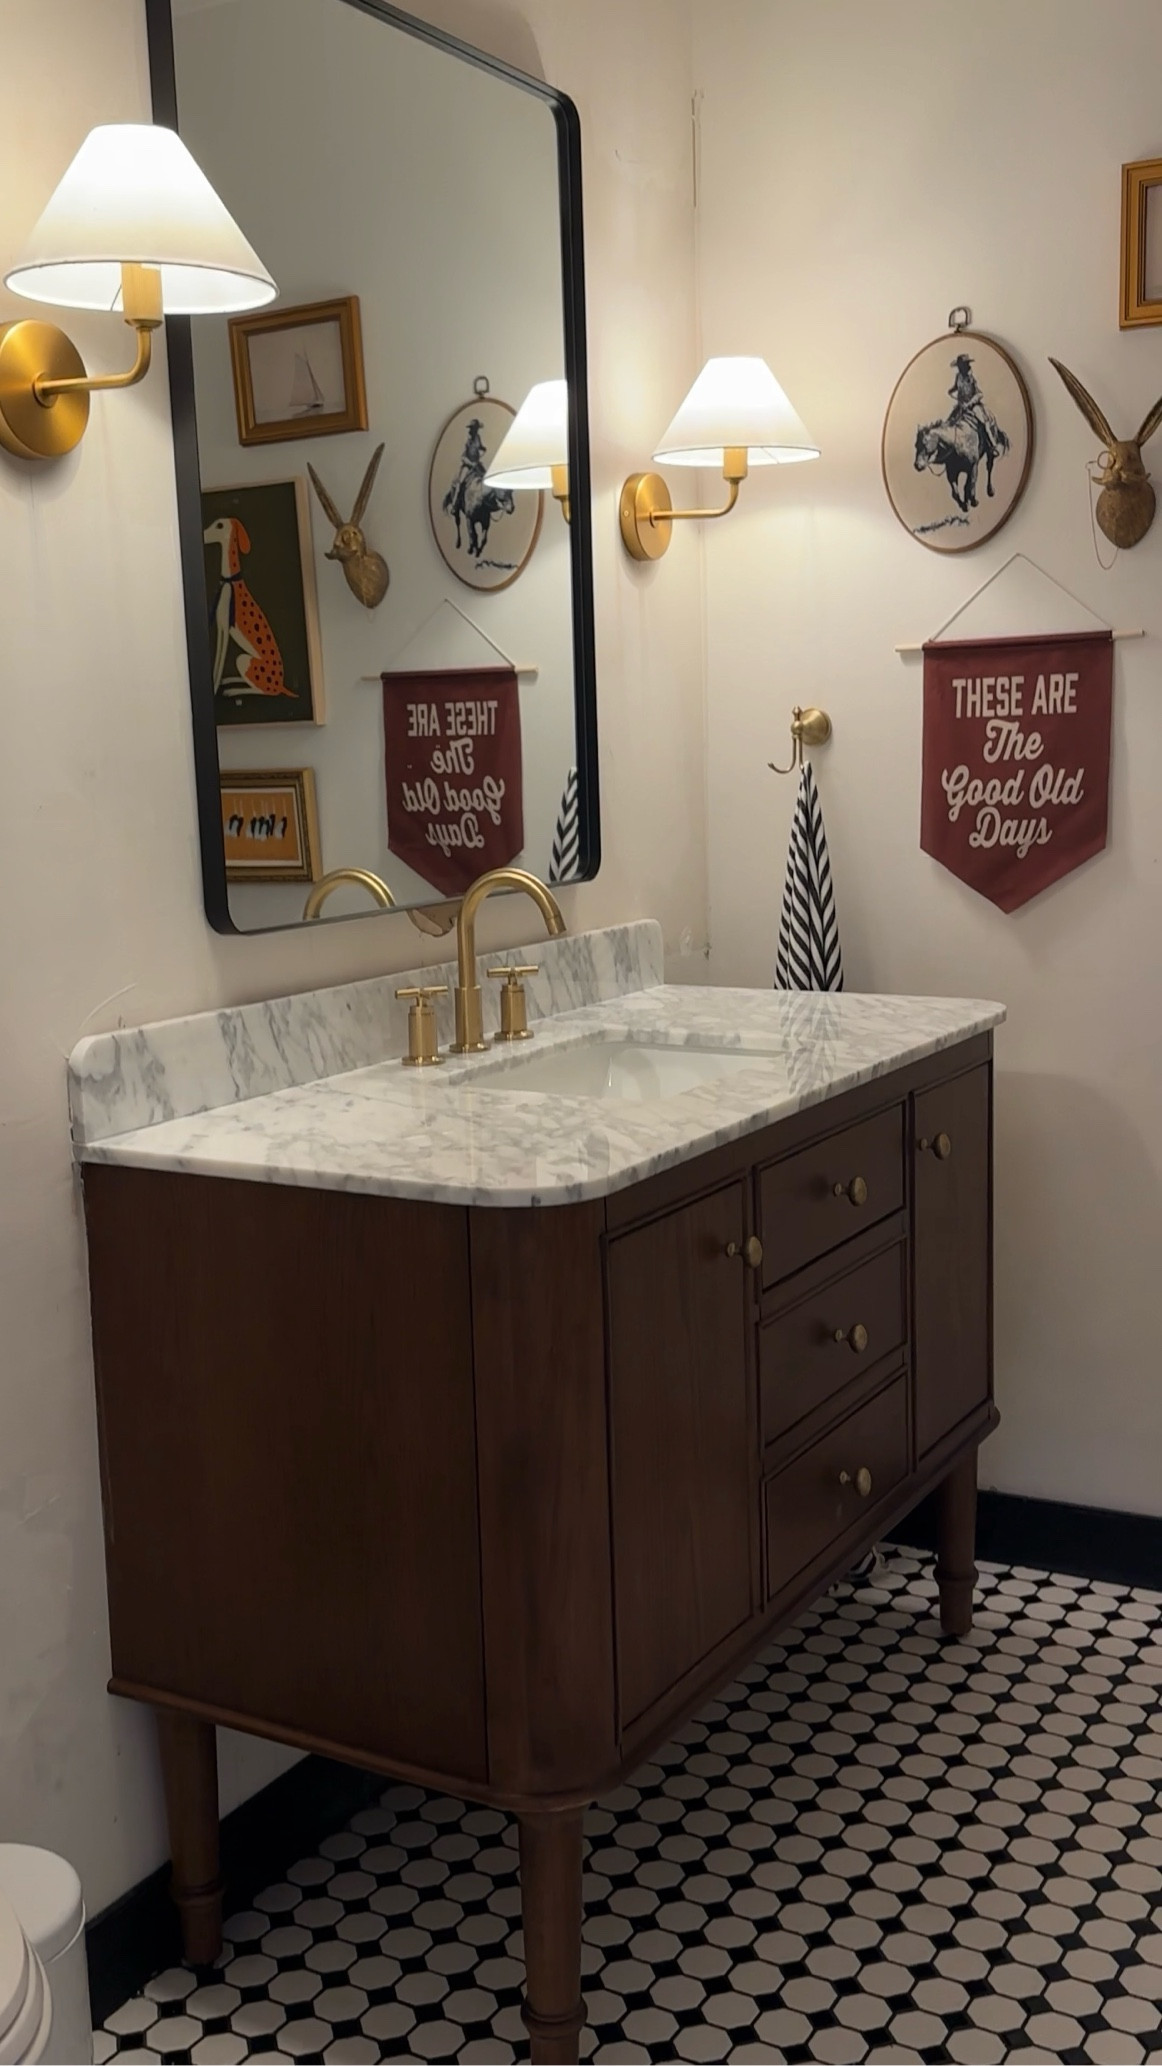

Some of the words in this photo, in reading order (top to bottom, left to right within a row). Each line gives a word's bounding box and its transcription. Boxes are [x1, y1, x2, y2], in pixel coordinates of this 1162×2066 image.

[952, 675, 1024, 718] THESE
[1031, 672, 1079, 715] ARE
[983, 718, 1044, 763] The
[941, 764, 1024, 822] Good
[1028, 763, 1085, 809] Old
[968, 806, 1052, 859] Days
